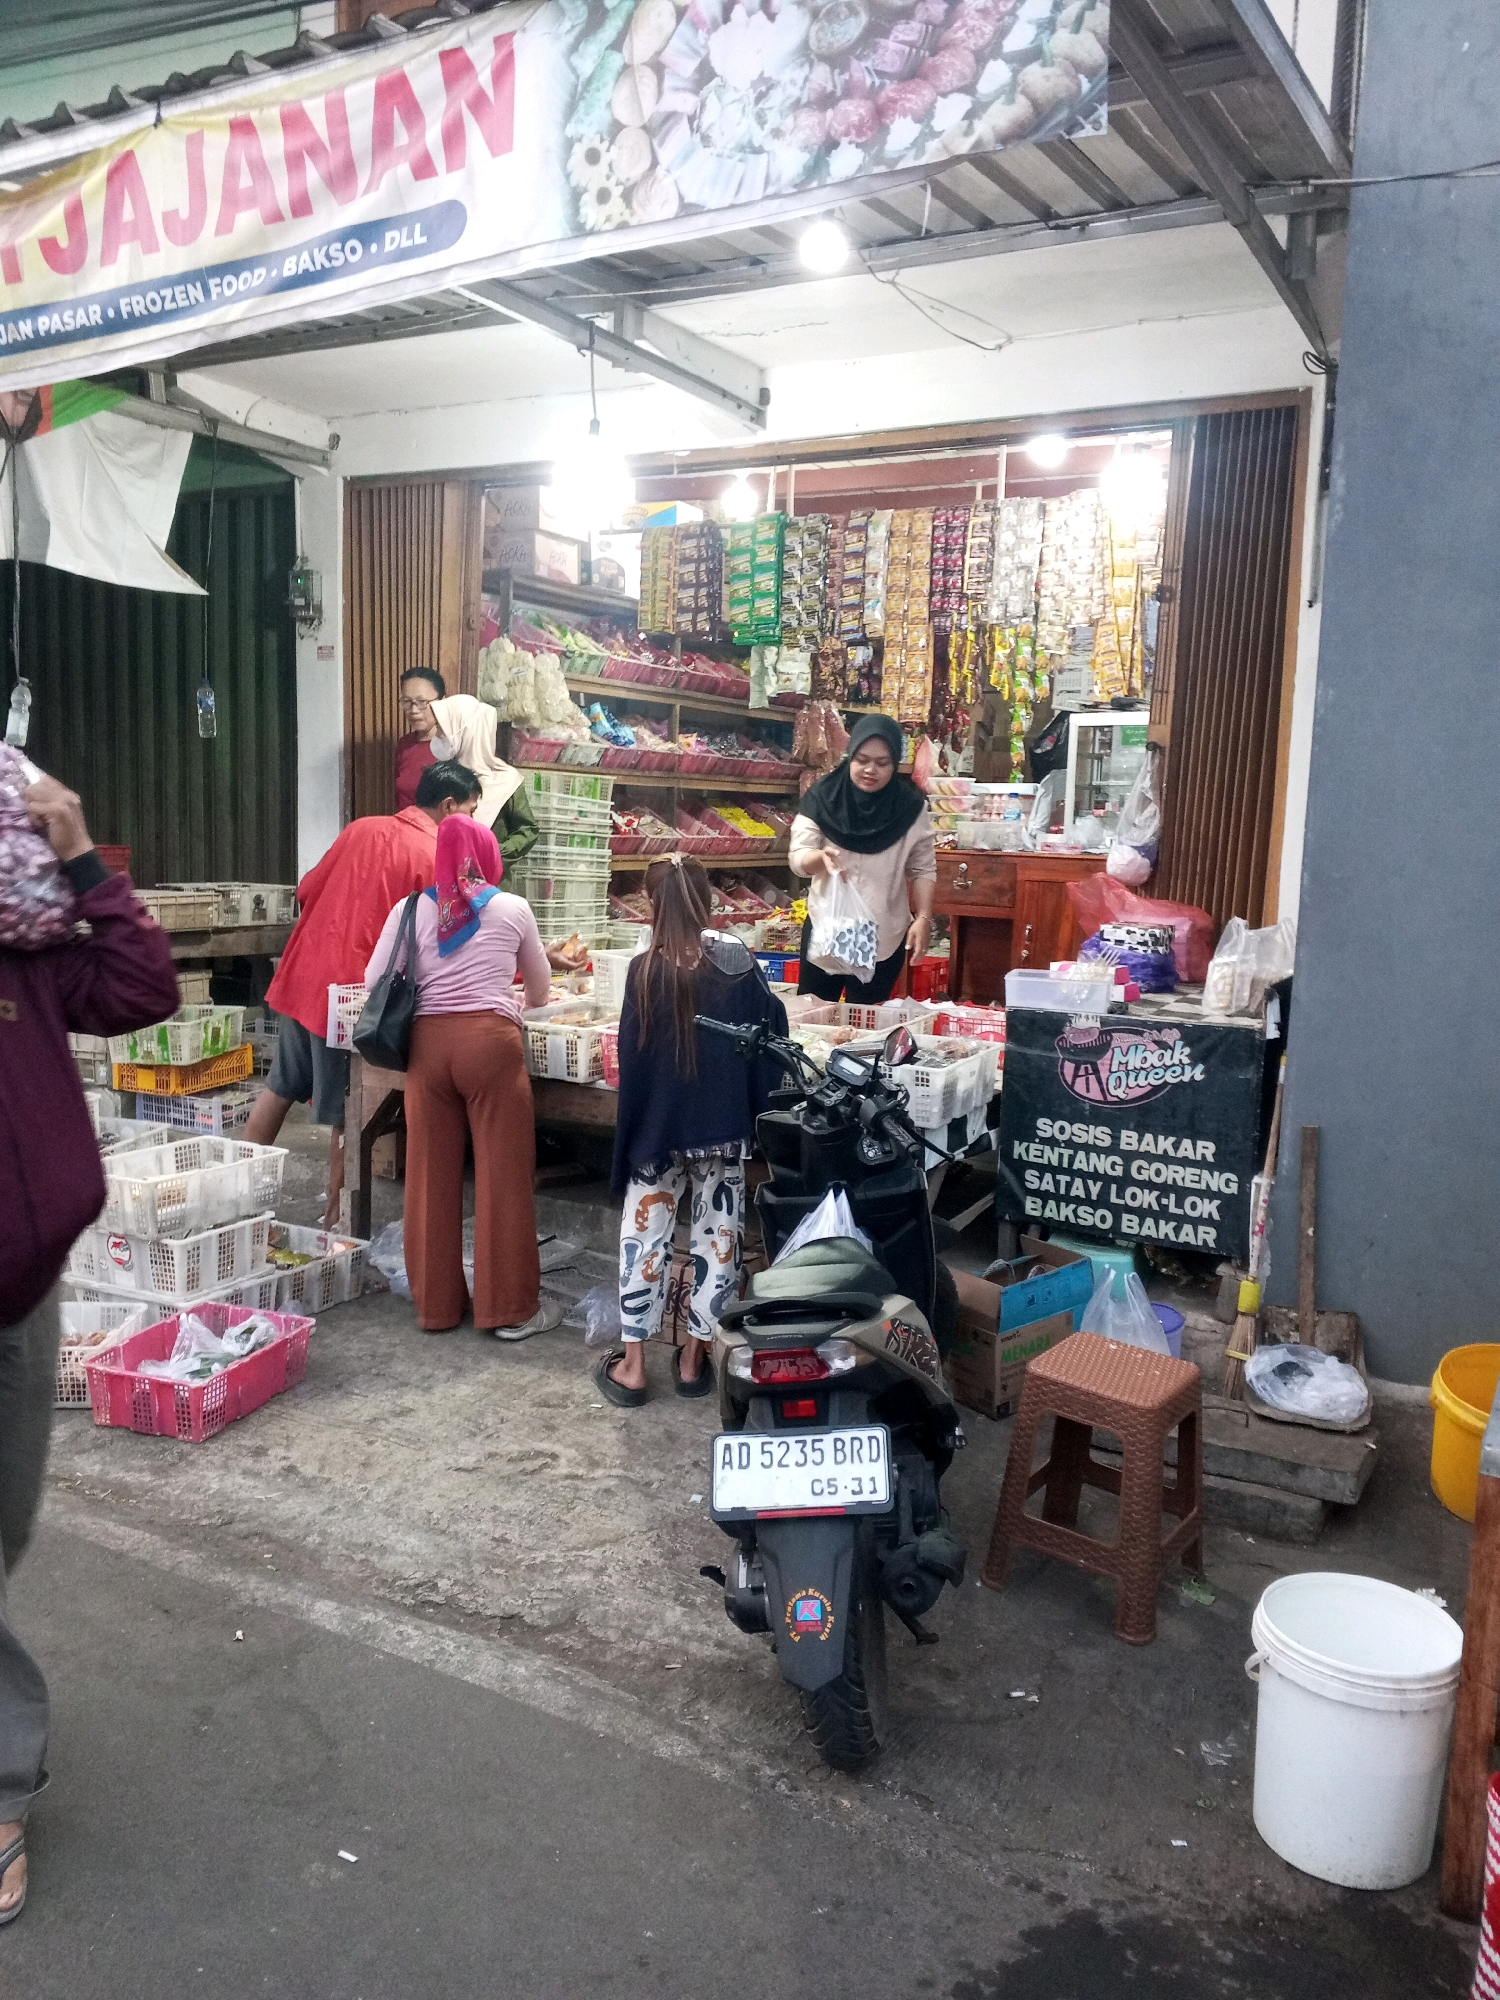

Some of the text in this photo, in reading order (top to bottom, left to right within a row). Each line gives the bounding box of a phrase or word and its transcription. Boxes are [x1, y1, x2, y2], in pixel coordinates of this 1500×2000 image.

[37, 31, 518, 277] JAJANAN
[37, 303, 103, 337] PASAR
[119, 281, 205, 319] FROZEN
[209, 267, 266, 301] FOOD
[282, 238, 364, 279] BAKSO
[384, 222, 428, 254] DLL
[1107, 1064, 1205, 1100] Queen
[1110, 1041, 1191, 1072] Mbak
[1036, 1118, 1217, 1163] SOSIS BAKAR
[1013, 1141, 1239, 1195] KENTANG GORENG
[1024, 1170, 1222, 1221] SATAY LOK-LOK
[1024, 1196, 1218, 1248] BAKSO BAKAR
[721, 1435, 881, 1470] AD 5235 BRD
